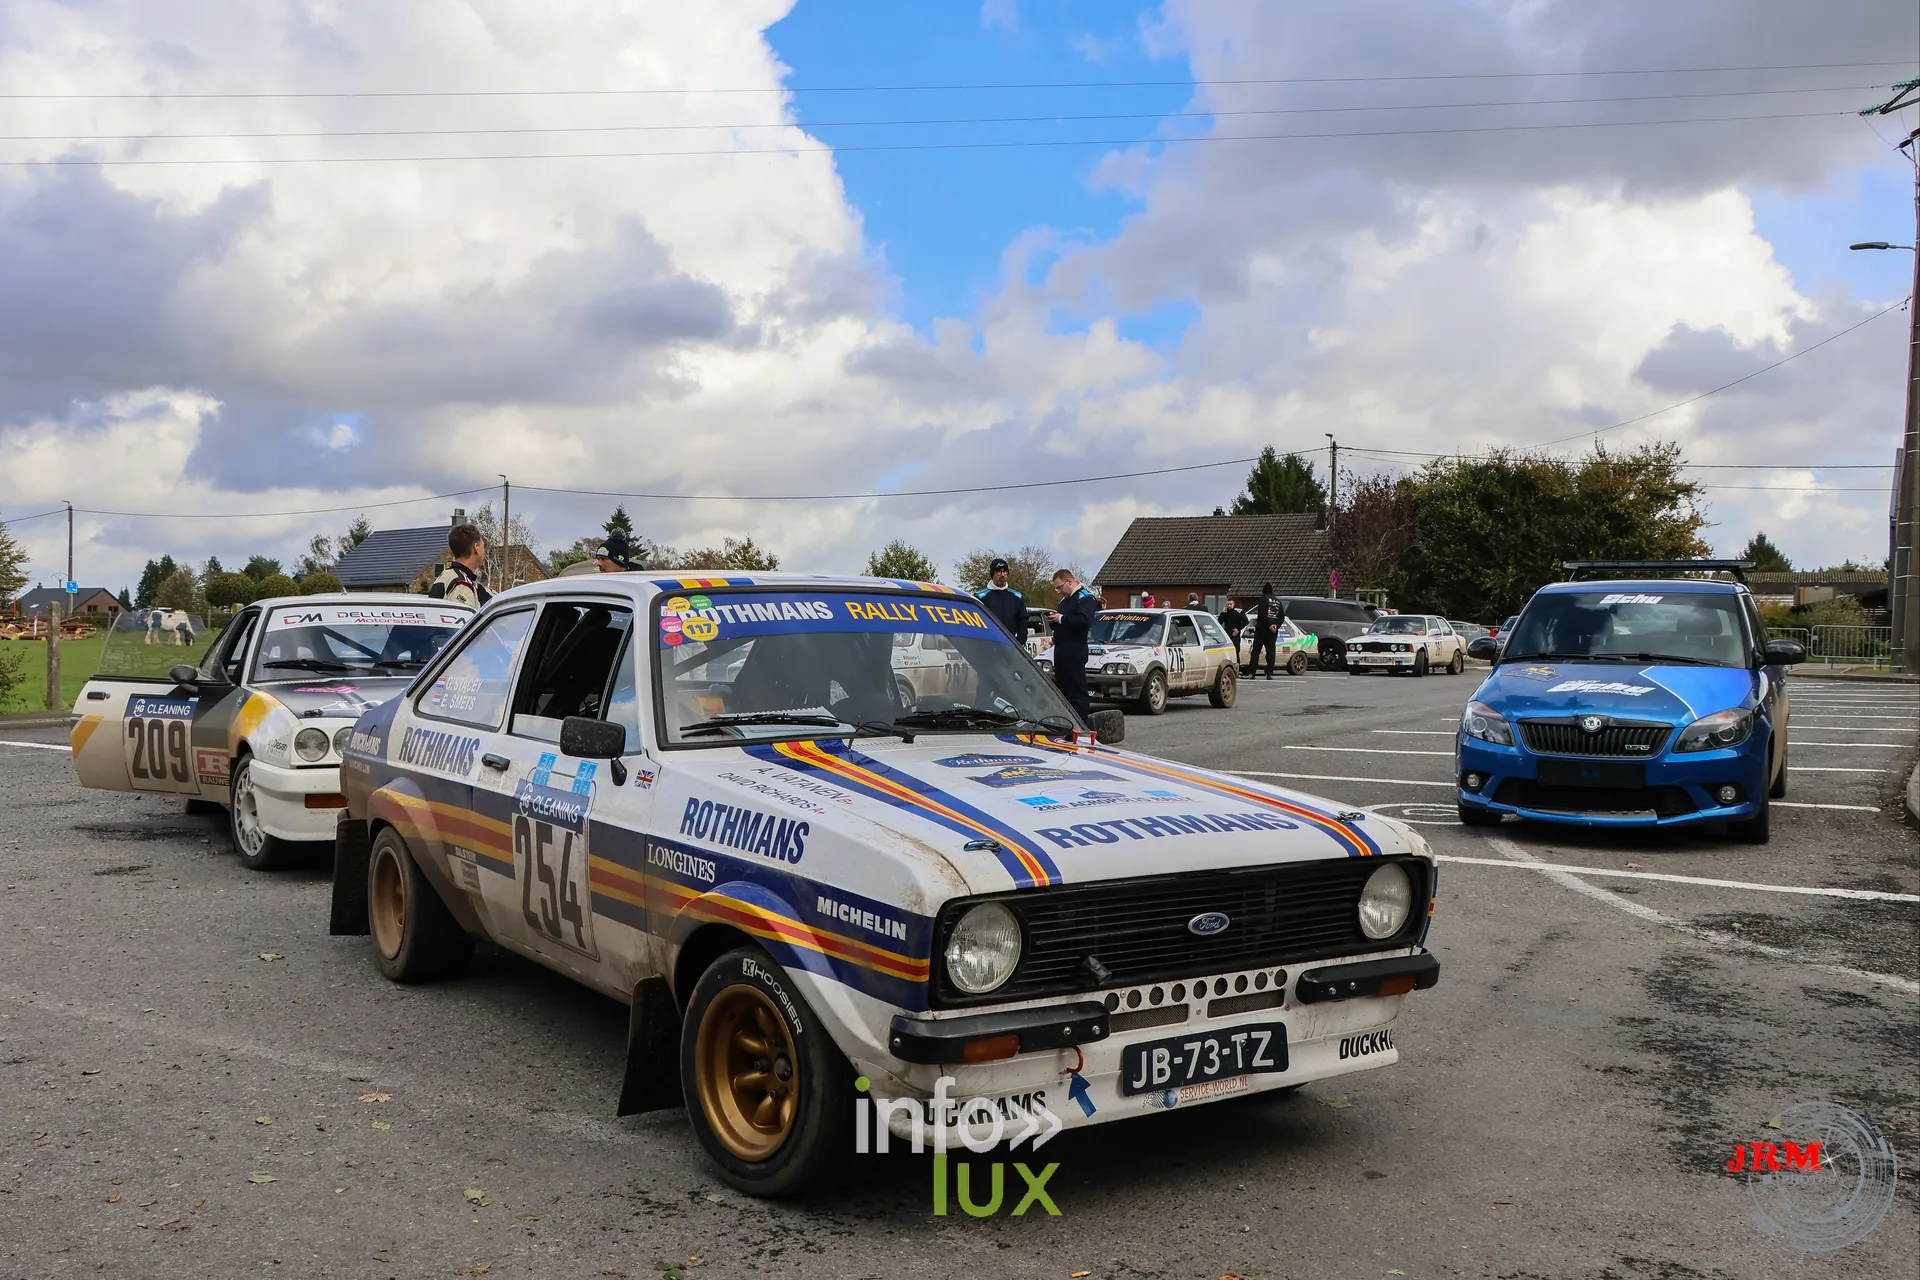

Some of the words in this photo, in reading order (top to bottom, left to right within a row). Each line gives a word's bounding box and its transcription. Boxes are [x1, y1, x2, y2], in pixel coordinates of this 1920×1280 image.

[337, 611, 427, 620] DELLEUSE
[354, 617, 428, 625] Motorsport
[686, 623, 712, 635] 117
[845, 602, 919, 622] RALLY
[920, 605, 988, 630] TEAM
[1167, 648, 1185, 673] 216
[147, 703, 191, 716] CLEANING
[440, 693, 448, 707] E.
[449, 694, 477, 711] SMETS
[128, 717, 190, 783] 209
[398, 726, 480, 777] ROTHMANS
[717, 771, 756, 787] DAVID
[749, 782, 817, 809] RICHARDS
[750, 766, 774, 775] A.
[771, 771, 850, 800] VATANEN
[532, 795, 581, 824] CLEANING
[680, 797, 810, 865] ROTHMANS
[1034, 812, 1300, 849] ROTHMANS
[647, 843, 717, 884] LONGINES
[515, 815, 587, 951] 254
[816, 895, 907, 941] MICHELIN
[1199, 916, 1221, 930] Ford
[754, 965, 803, 1035] HOOSIER
[1132, 1031, 1275, 1090] JB-73-TZ
[1179, 1076, 1248, 1100] SERVICE-WORLD.NL
